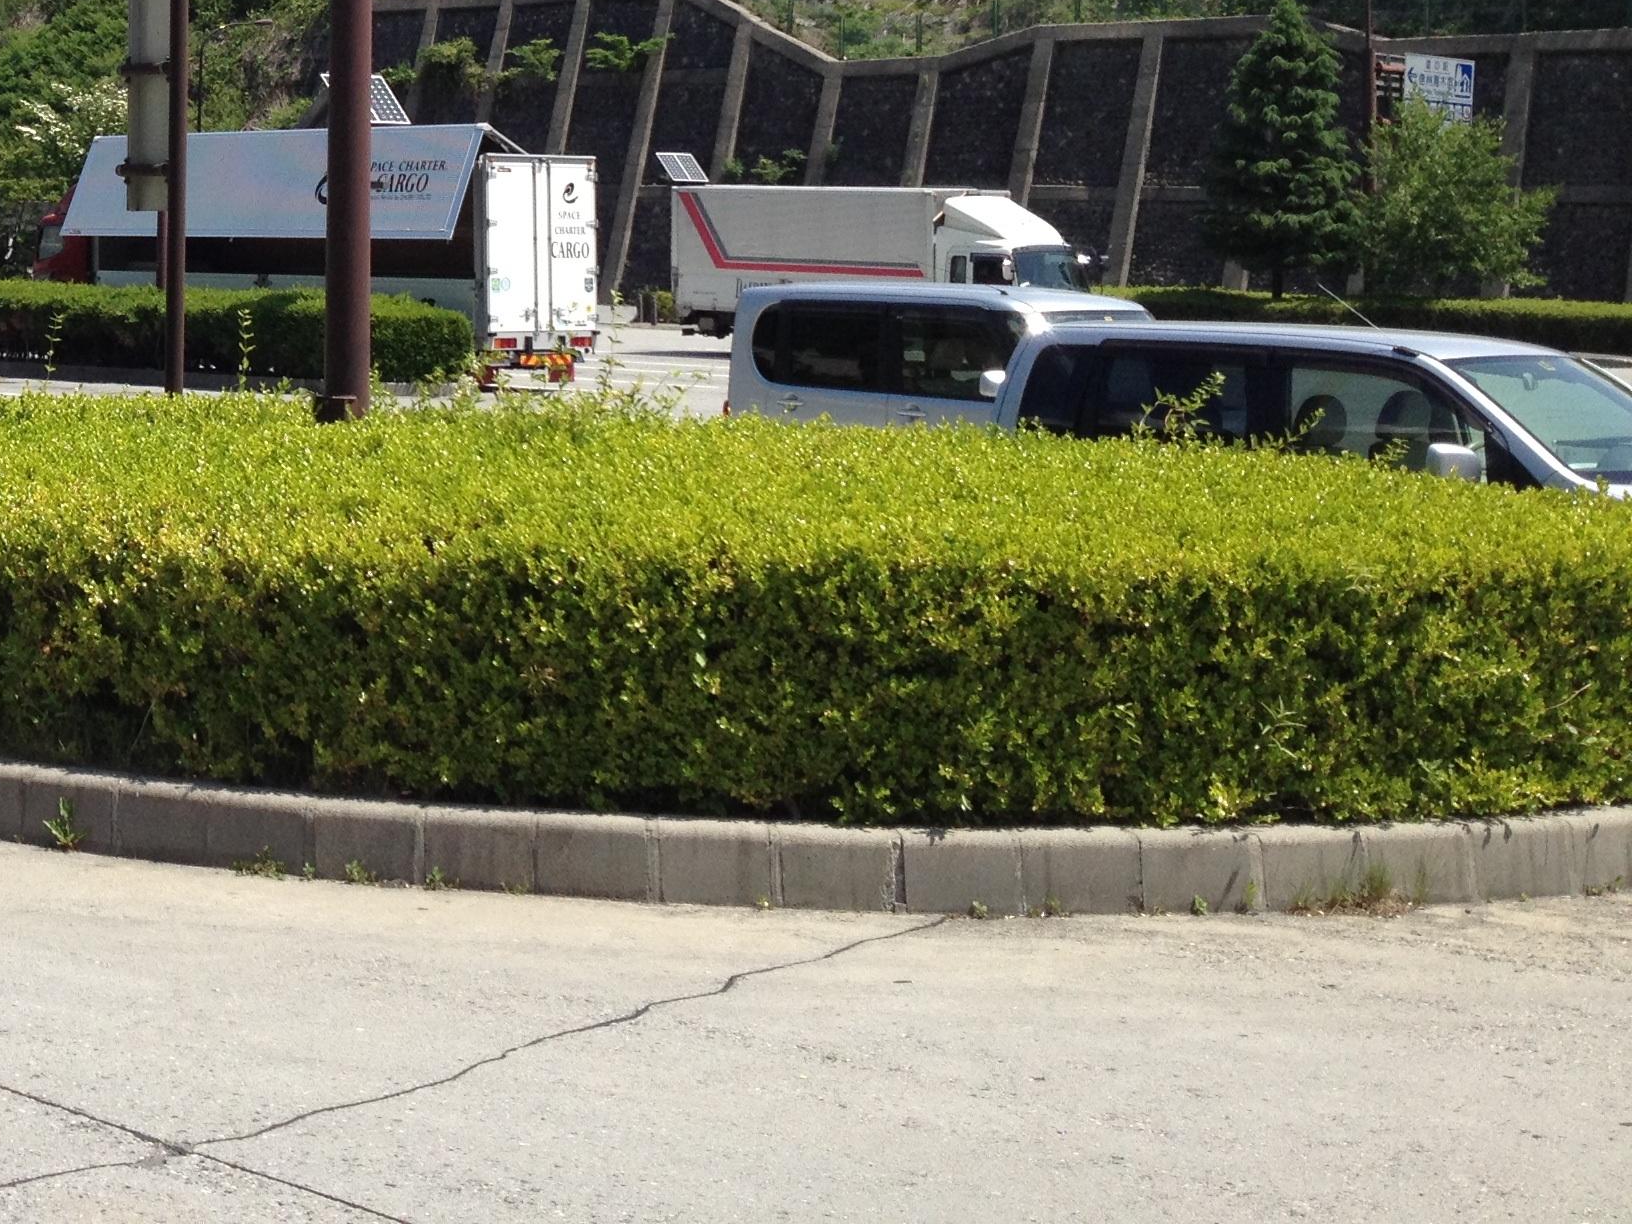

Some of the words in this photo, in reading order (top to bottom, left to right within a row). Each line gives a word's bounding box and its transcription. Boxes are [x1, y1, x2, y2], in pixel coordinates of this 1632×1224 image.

[370, 160, 395, 172] PACE
[398, 159, 447, 172] CHARTER
[558, 211, 581, 220] SPACE
[554, 226, 586, 235] CHARTER
[551, 241, 590, 259] CARGO
